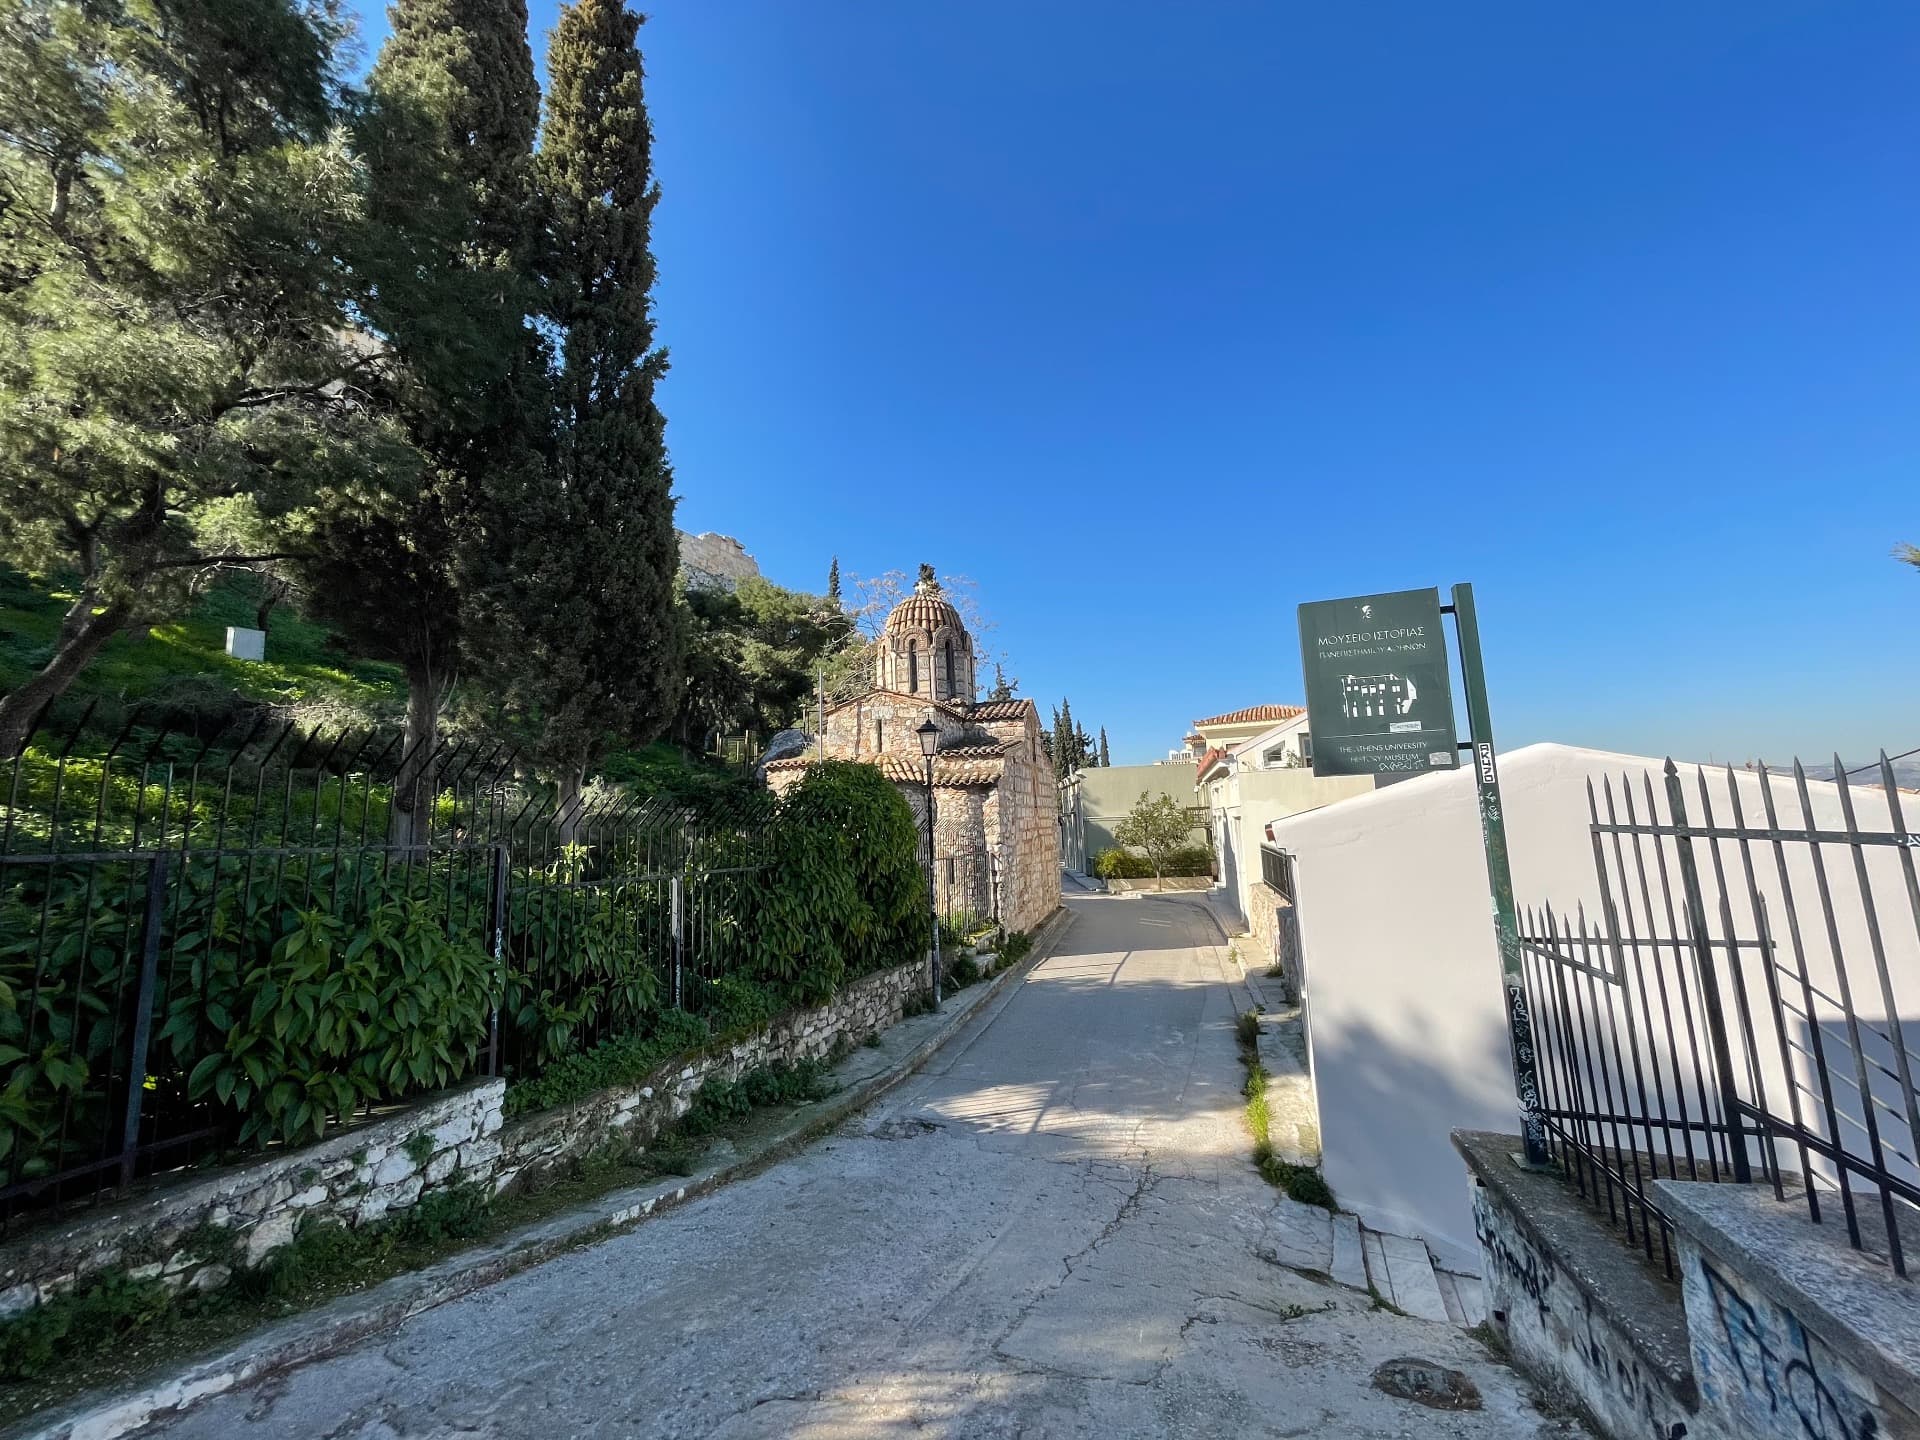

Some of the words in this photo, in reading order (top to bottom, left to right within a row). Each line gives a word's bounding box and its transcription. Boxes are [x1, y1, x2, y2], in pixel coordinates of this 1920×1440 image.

[1318, 632, 1371, 646] ΜΟΥΣΕΙΟ
[1373, 626, 1425, 641] ΙΣΤΟΡΙΑΣ
[1384, 741, 1428, 751] UNIVERSITY
[1384, 753, 1420, 762] MUSEUM
